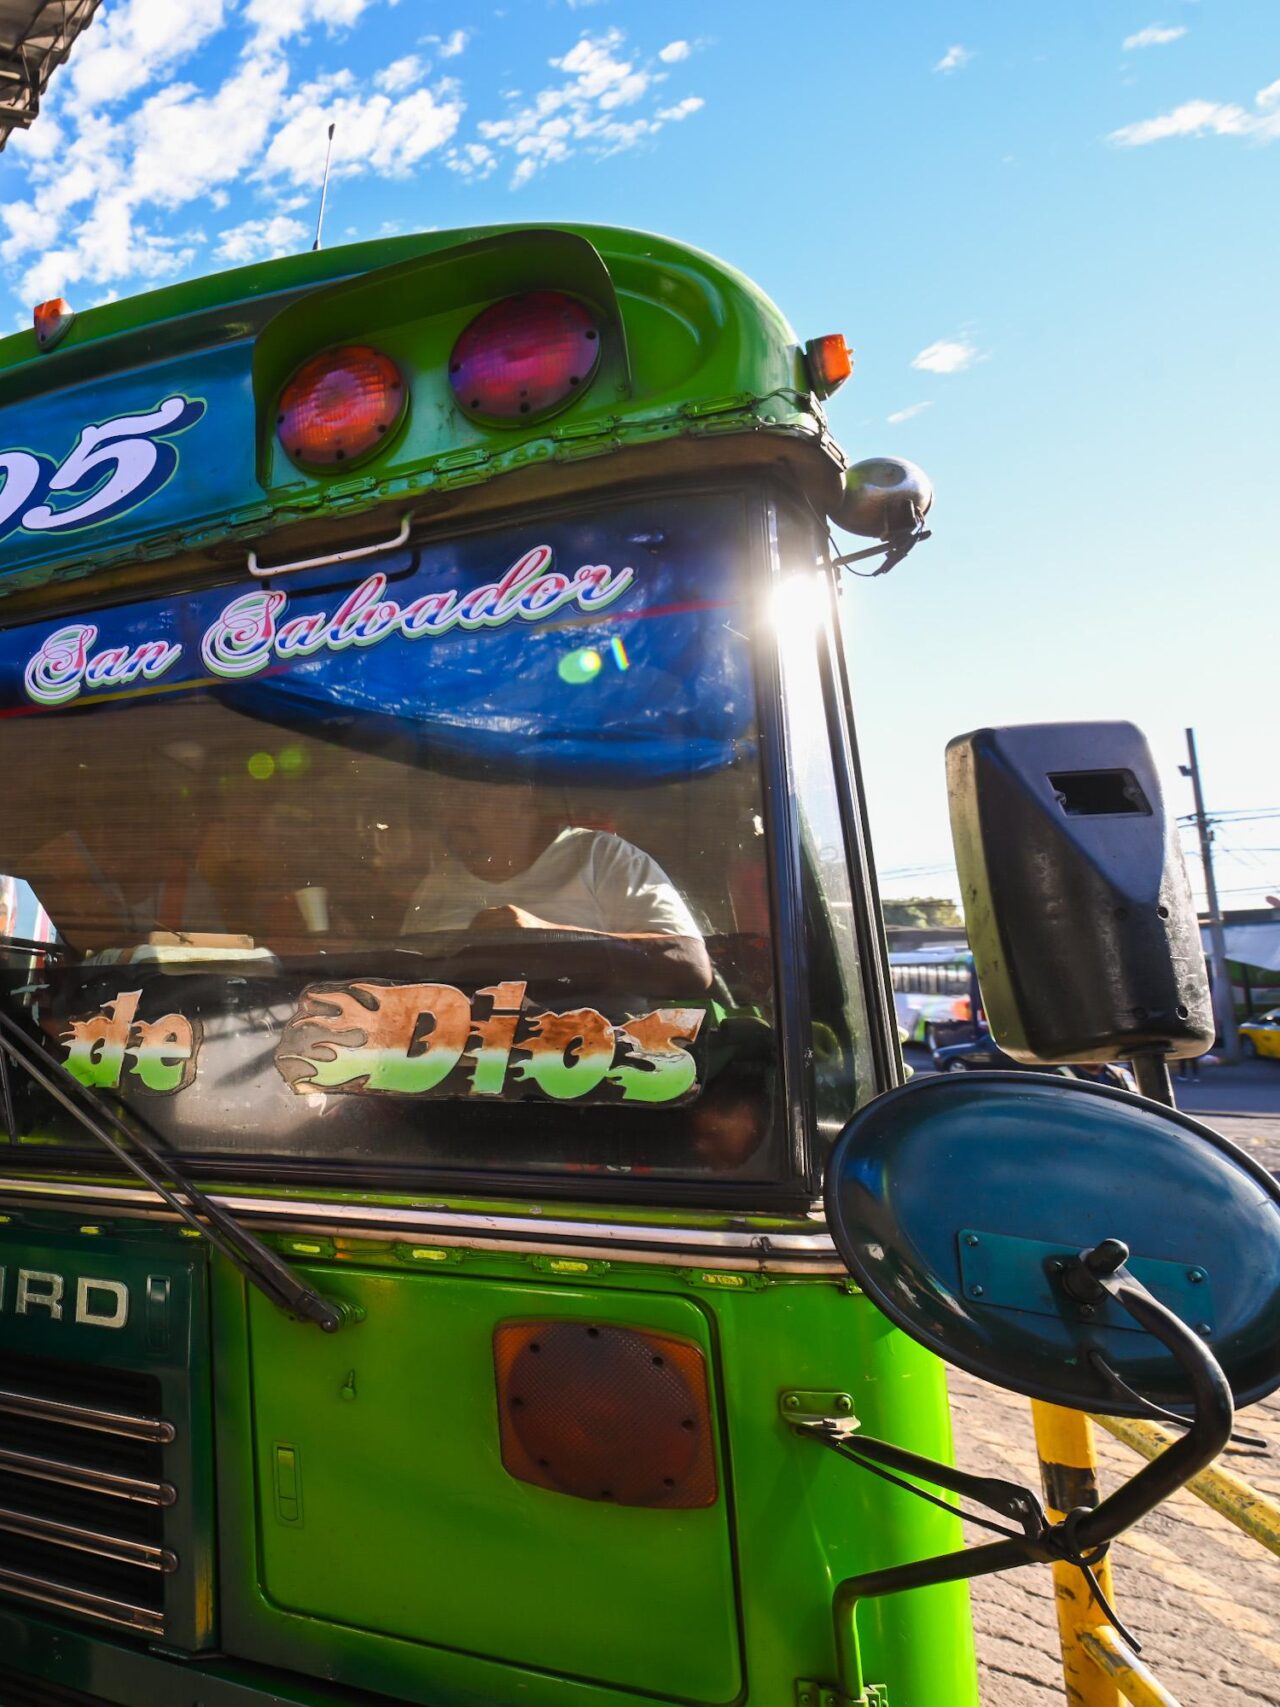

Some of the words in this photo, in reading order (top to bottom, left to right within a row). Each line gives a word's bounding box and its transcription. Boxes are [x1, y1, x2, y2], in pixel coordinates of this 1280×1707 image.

[24, 624, 182, 704] San
[201, 544, 634, 679] Salvador
[60, 989, 196, 1092] de
[285, 980, 706, 1100] Dios
